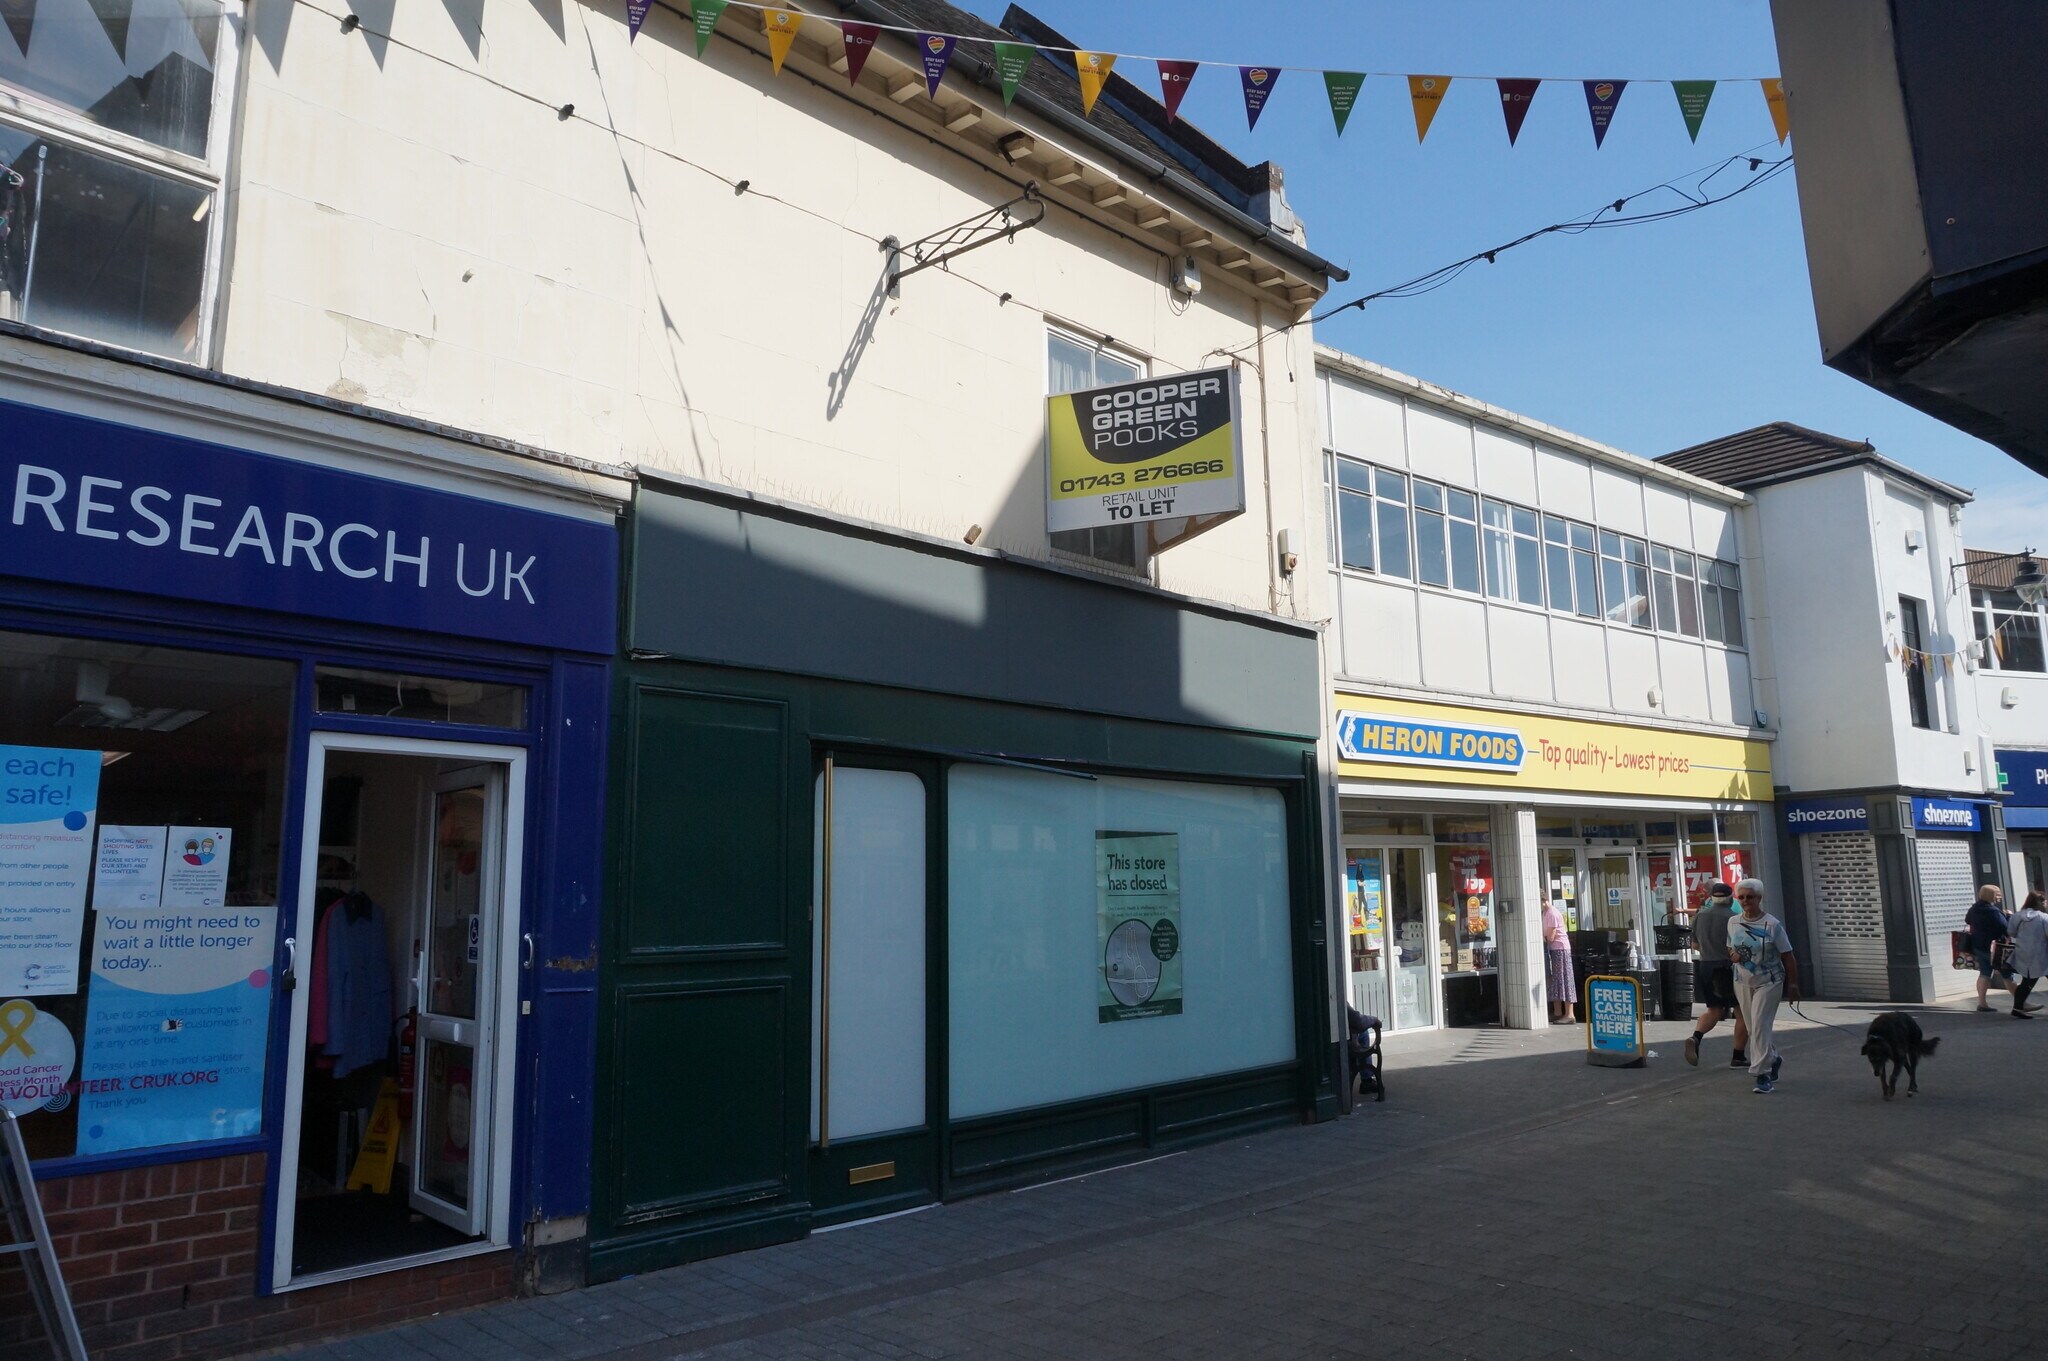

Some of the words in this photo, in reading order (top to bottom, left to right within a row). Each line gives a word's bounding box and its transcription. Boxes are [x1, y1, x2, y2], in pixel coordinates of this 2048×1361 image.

[1091, 377, 1221, 412] COOPER
[1092, 400, 1198, 431] GREEN
[1094, 420, 1199, 450] POOKS
[1059, 472, 1126, 493] 01743
[1134, 459, 1224, 483] 276666
[1102, 491, 1145, 507] RETAIL
[1148, 486, 1178, 499] UNIT
[1107, 504, 1133, 520] TO
[1139, 499, 1175, 517] LET
[12, 463, 430, 588] RESEARCH
[456, 542, 536, 605] UK
[1362, 723, 1443, 755] HERON
[1449, 732, 1518, 761] FOODS
[1539, 738, 1561, 771] Top
[1658, 751, 1690, 778] prices
[5, 756, 75, 778] each
[6, 784, 72, 806] safe!
[1788, 808, 1867, 822] shoezone
[1924, 802, 1973, 827] shoezone
[1107, 853, 1130, 870] This
[1134, 856, 1165, 870] store
[1462, 855, 1480, 866] NOW
[1724, 853, 1737, 865] ONLY
[1108, 874, 1127, 890] has
[1130, 874, 1167, 890] closed
[1461, 868, 1486, 893] 75p
[106, 916, 137, 930] You
[143, 915, 192, 932] might
[197, 915, 238, 928] need
[244, 916, 260, 928] to
[103, 936, 139, 950] wait
[144, 938, 153, 948] a
[159, 934, 194, 948] little
[200, 934, 253, 950] longer
[102, 955, 162, 972] today...
[1594, 988, 1632, 1003] FREE
[96, 1011, 119, 1021] Due
[122, 1011, 133, 1020] to
[137, 1009, 167, 1018] social
[170, 1006, 223, 1017] distancing
[226, 1005, 242, 1013] we
[1595, 1002, 1633, 1015] CASH
[1596, 1013, 1633, 1022] MACHINE
[95, 1027, 110, 1035] are
[115, 1023, 159, 1034] allowing
[184, 1019, 239, 1029] customers
[1596, 1021, 1633, 1035] HERE
[93, 1042, 103, 1050] at
[105, 1040, 125, 1049] any
[22, 1064, 63, 1074] Cancer
[92, 1062, 126, 1072] Please
[129, 1060, 149, 1069] use
[151, 1057, 168, 1067] the
[171, 1055, 198, 1065] hand
[202, 1053, 243, 1063] sanitiser
[224, 1066, 250, 1075] store
[24, 1075, 60, 1085] Month
[130, 1070, 219, 1090] CRUK.ORG
[88, 1098, 124, 1110] Thank
[126, 1096, 147, 1108] you
